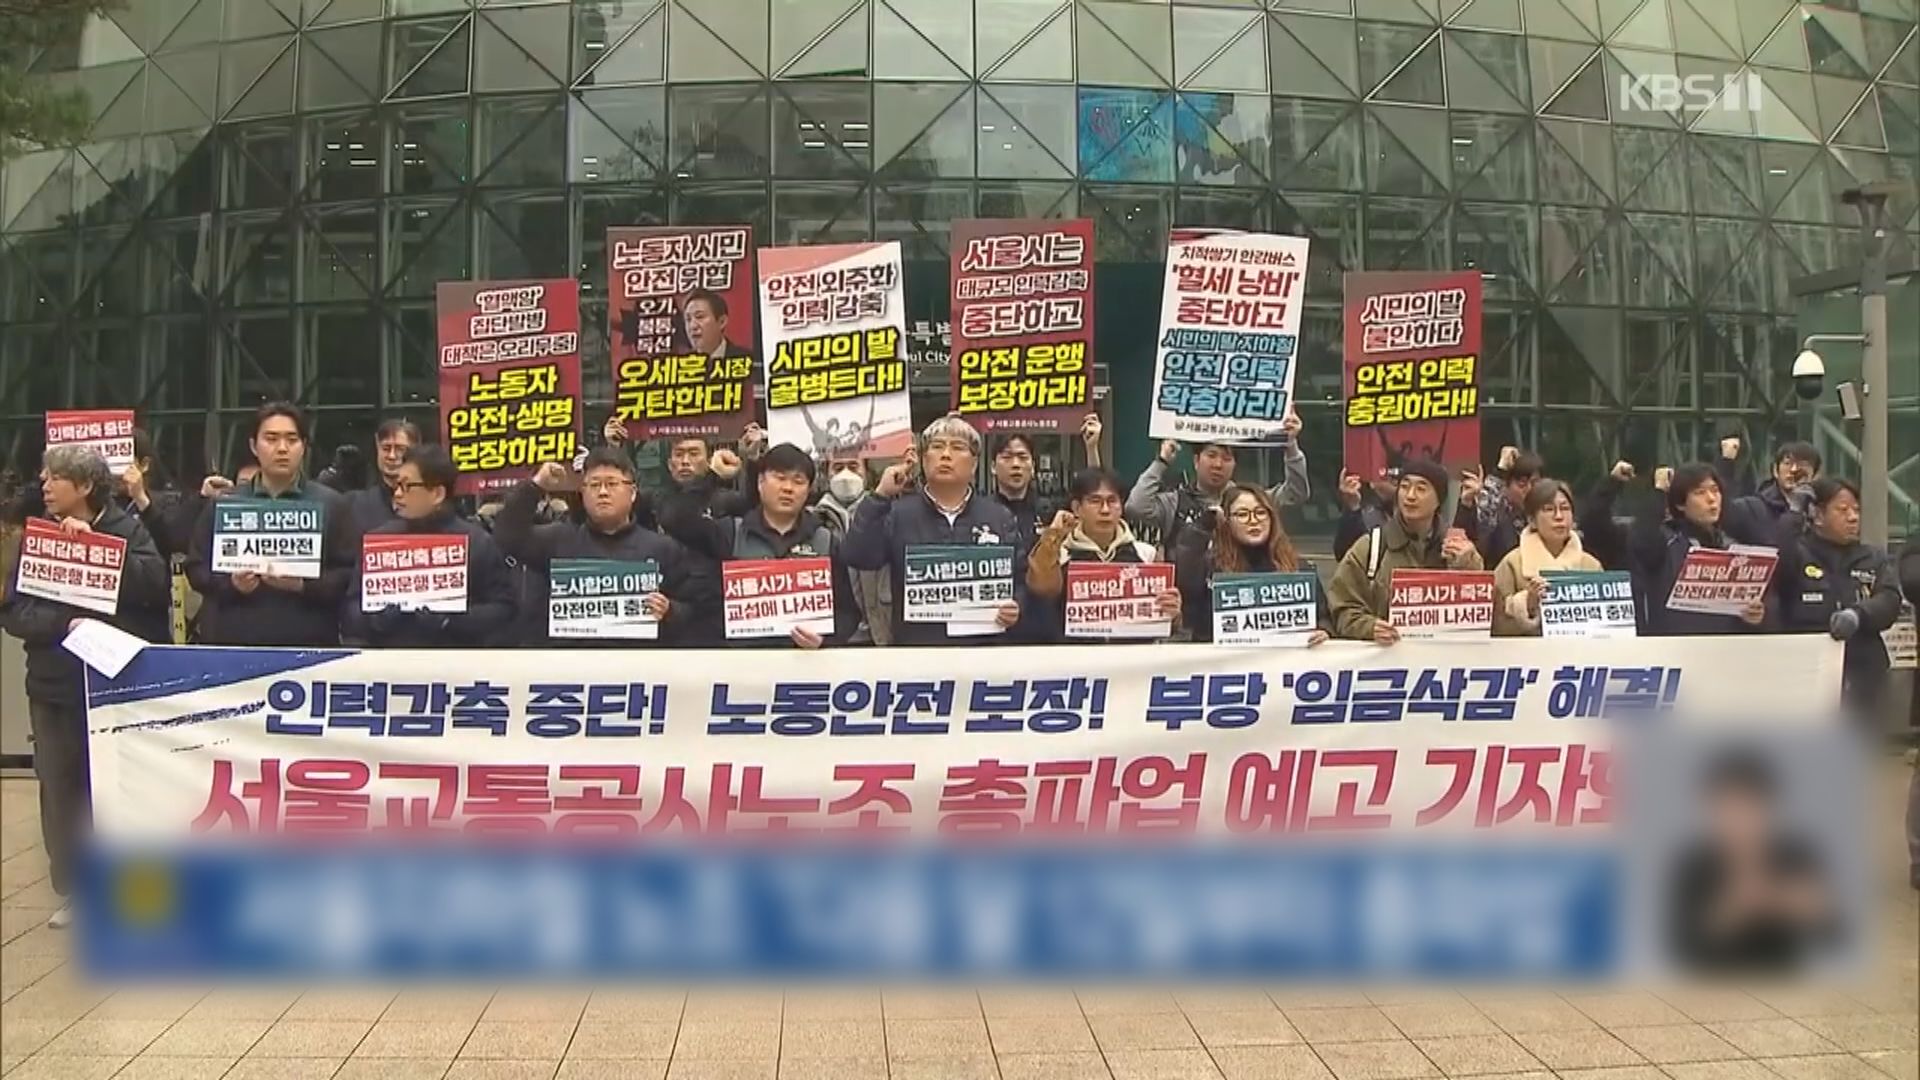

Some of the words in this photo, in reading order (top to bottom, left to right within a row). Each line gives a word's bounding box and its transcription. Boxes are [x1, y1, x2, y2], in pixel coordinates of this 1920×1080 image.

[613, 235, 692, 269] 노동자
[692, 231, 746, 262] 시민
[961, 233, 1085, 271] 서울시는
[1240, 249, 1296, 267] 한강버스
[624, 266, 677, 297] 안전
[679, 260, 732, 292] 위협
[767, 273, 815, 301] 안전
[820, 264, 894, 294] 외주화
[957, 275, 1014, 299] 대규모
[782, 297, 829, 325] 인력
[835, 292, 884, 320] 감축
[962, 298, 1083, 337] 중단하고
[1176, 296, 1287, 328] 중단하고
[1361, 293, 1437, 324] 시민의
[1437, 289, 1466, 318] 발
[471, 309, 546, 338] 집단발병
[1364, 318, 1463, 353] 불안하다
[441, 341, 498, 366] 대책은
[770, 334, 861, 372] 시민의
[866, 328, 898, 361] 발
[1161, 329, 1217, 351] 시민의
[1241, 333, 1296, 356] 지하철
[618, 355, 707, 389] 오세훈
[710, 356, 752, 379] 시장
[960, 349, 1019, 380] 안전
[1025, 342, 1085, 375] 운행
[1163, 351, 1226, 383] 안전
[1228, 355, 1289, 388] 인력
[1357, 364, 1412, 393] 안전
[1419, 356, 1476, 387] 인력
[469, 366, 558, 401] 노동자
[769, 362, 904, 407] 골병든다!!
[959, 375, 1085, 413] 보장하라!
[616, 382, 742, 420] 규탄한다!
[1158, 384, 1288, 420] 확충하라!
[1347, 389, 1476, 426] 충원하라!!
[49, 422, 102, 441] 인력감축
[104, 420, 133, 436] 중단
[451, 432, 575, 471] 보장하라!
[222, 511, 259, 530] 노동
[264, 510, 317, 531] 안전이
[26, 536, 87, 563] 인력감축
[90, 545, 121, 566] 중단
[243, 537, 314, 557] 시민안전
[365, 549, 429, 571] 인력감축
[431, 545, 465, 564] 중단
[22, 560, 84, 585] 안전운행
[86, 569, 118, 591] 보장
[365, 574, 430, 595] 안전운행
[432, 572, 465, 591] 보장
[551, 576, 618, 596] 노사합의
[623, 573, 657, 592] 이행
[725, 573, 793, 597] 서울시가
[796, 568, 832, 590] 즉각
[906, 561, 973, 582] 노사합의
[979, 558, 1012, 577] 이행
[907, 584, 973, 605] 안전인력
[1220, 588, 1255, 608] 노동
[1261, 582, 1311, 602] 안전이
[1391, 584, 1456, 604] 서울시가
[1460, 583, 1493, 601] 즉각
[1673, 584, 1731, 599] 안전대책
[552, 600, 618, 620] 안전인력
[727, 600, 778, 621] 교섭에
[1068, 603, 1134, 622] 안전대책
[1242, 609, 1309, 631] 시민안전
[1391, 608, 1439, 627] 교섭에
[1544, 604, 1602, 623] 안전인력
[265, 680, 510, 738] 인력감축
[525, 682, 669, 738] 중단!
[706, 679, 956, 737] 노동안전
[965, 677, 1109, 734] 보장!
[1146, 672, 1267, 731] 부당
[1281, 667, 1539, 725] '임금삭감'
[188, 757, 916, 840] 서울교통공사노조
[936, 751, 1208, 840] 총파업
[1224, 749, 1398, 836] 예고
